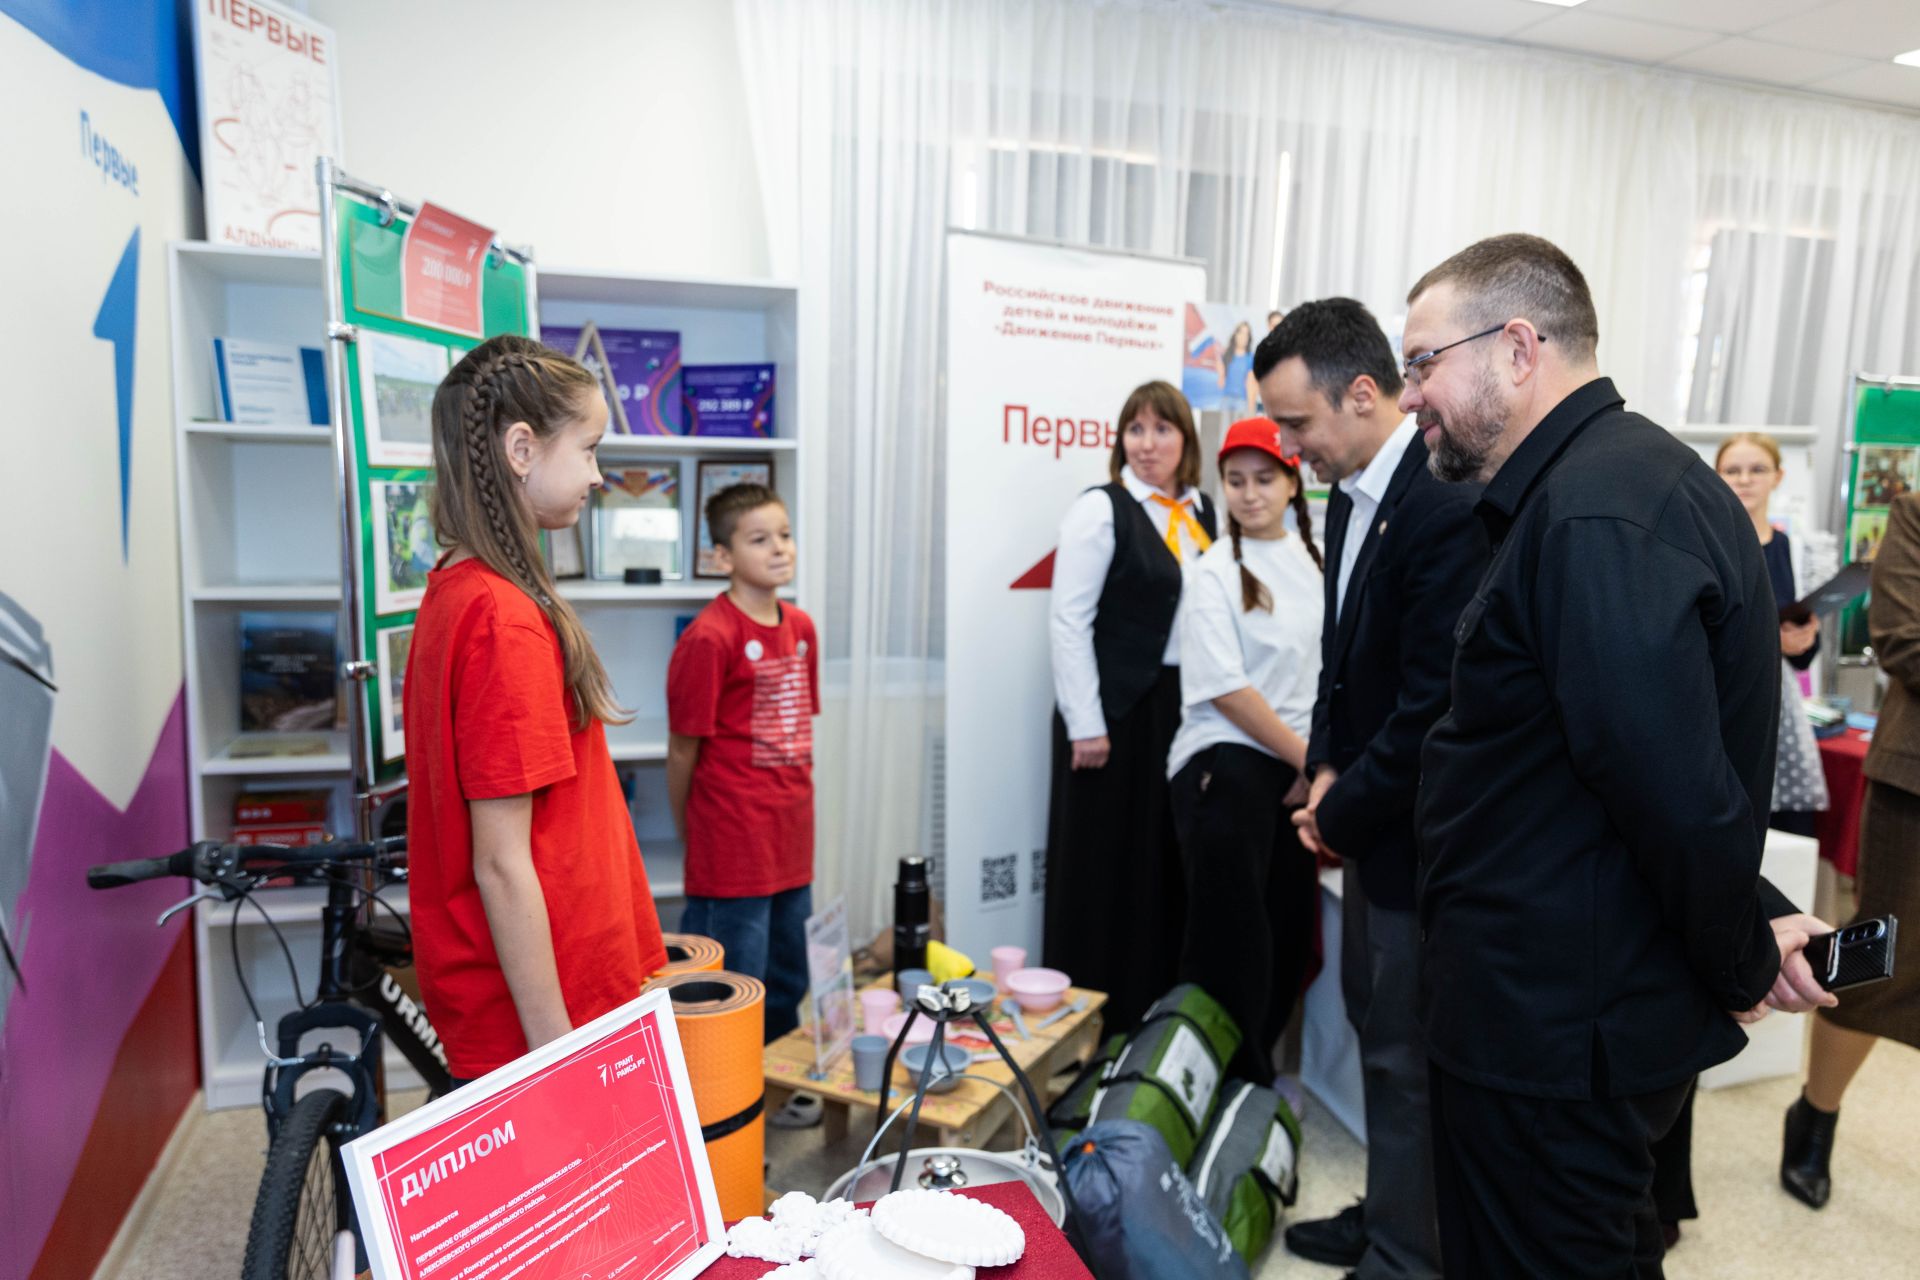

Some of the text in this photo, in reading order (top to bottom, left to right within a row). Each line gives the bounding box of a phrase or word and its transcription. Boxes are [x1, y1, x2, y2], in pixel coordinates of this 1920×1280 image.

[208, 0, 326, 64] ПЕРВЫЕ
[80, 110, 139, 197] Первые
[984, 280, 1174, 316] Российское движение
[1003, 305, 1158, 332] детей и молодёжи
[614, 1054, 634, 1070] ГРАНТ
[616, 1062, 638, 1079] РАИСА
[636, 1057, 646, 1068] РТ
[400, 1120, 516, 1207] ДИПЛОМ
[409, 1210, 459, 1243] Награждается
[416, 1237, 454, 1265] ПЕРВИЧНОЕ
[453, 1215, 489, 1241] ОТДЕЛЕНИЕ
[488, 1204, 506, 1219] МБОУ
[419, 1194, 547, 1278] АЛЕКСЕЕВСКОГО МУНИЦИПАЛЬНОГО РАЙОНА
[463, 1252, 494, 1275] Конкурсе
[494, 1247, 503, 1255] на
